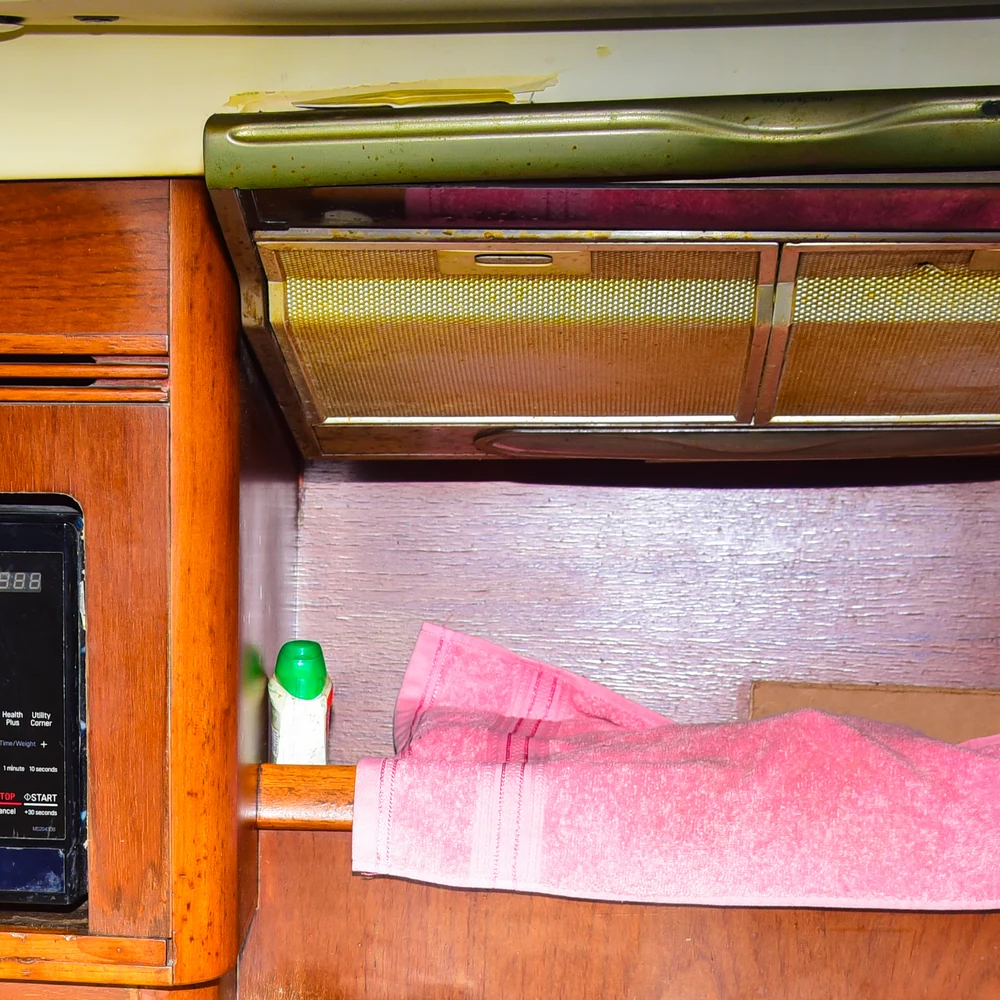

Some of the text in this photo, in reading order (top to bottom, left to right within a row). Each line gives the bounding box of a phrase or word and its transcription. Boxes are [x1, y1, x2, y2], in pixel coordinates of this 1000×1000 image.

[2, 711, 24, 719] Health
[31, 711, 52, 720] Utility
[5, 719, 20, 727] Plus
[30, 719, 53, 727] Corner
[0, 740, 36, 748] Time/Weight
[31, 794, 58, 802] START
